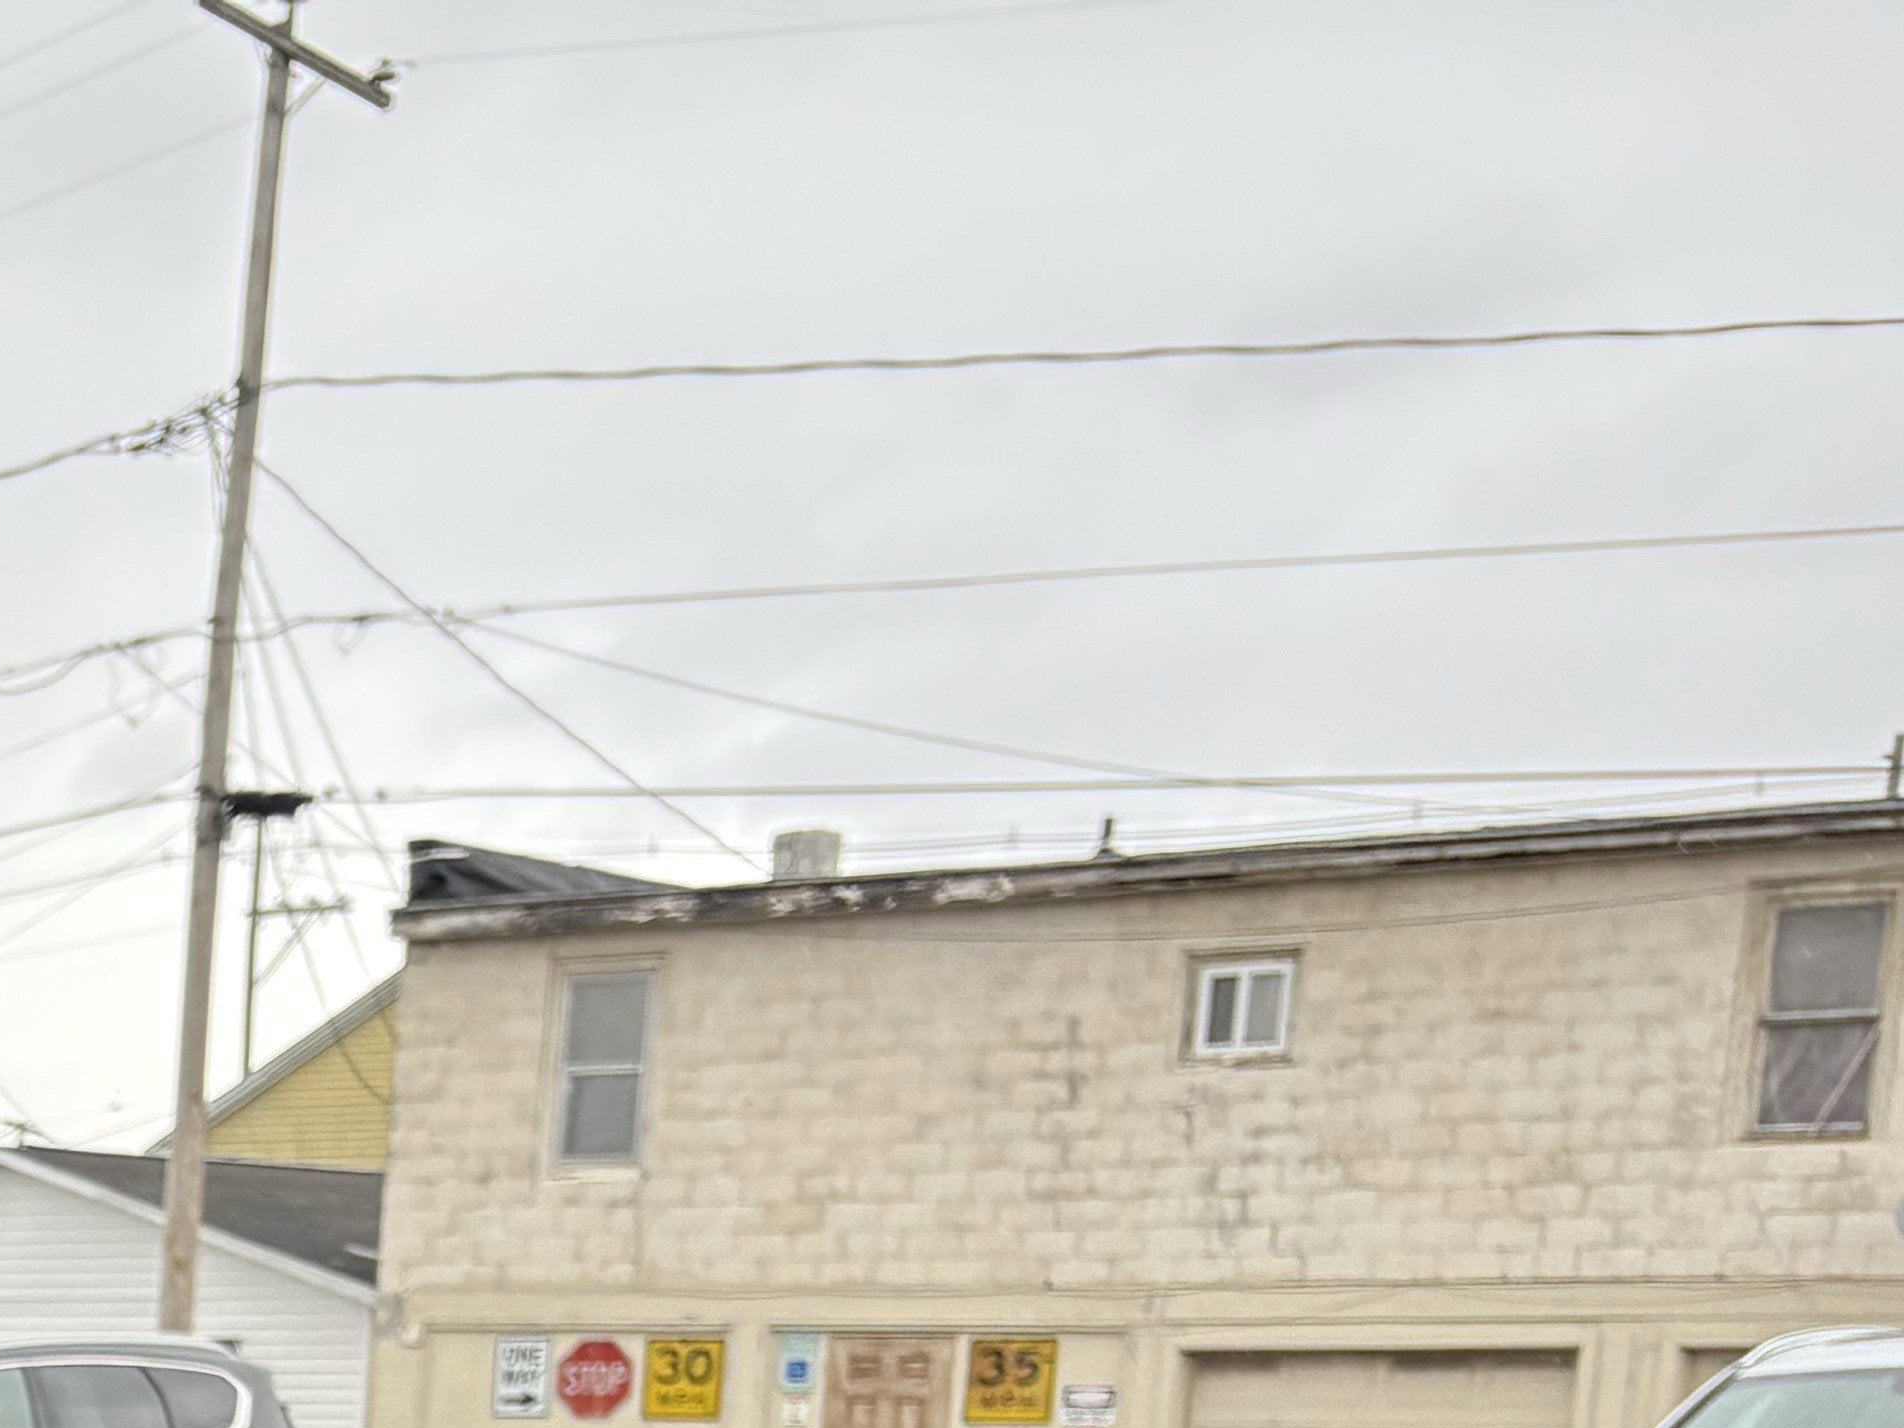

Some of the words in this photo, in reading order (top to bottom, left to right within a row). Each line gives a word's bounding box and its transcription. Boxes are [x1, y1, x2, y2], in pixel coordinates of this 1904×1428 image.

[565, 1359, 627, 1396] STOP
[654, 1347, 713, 1386] 30
[976, 1347, 1040, 1387] 35
